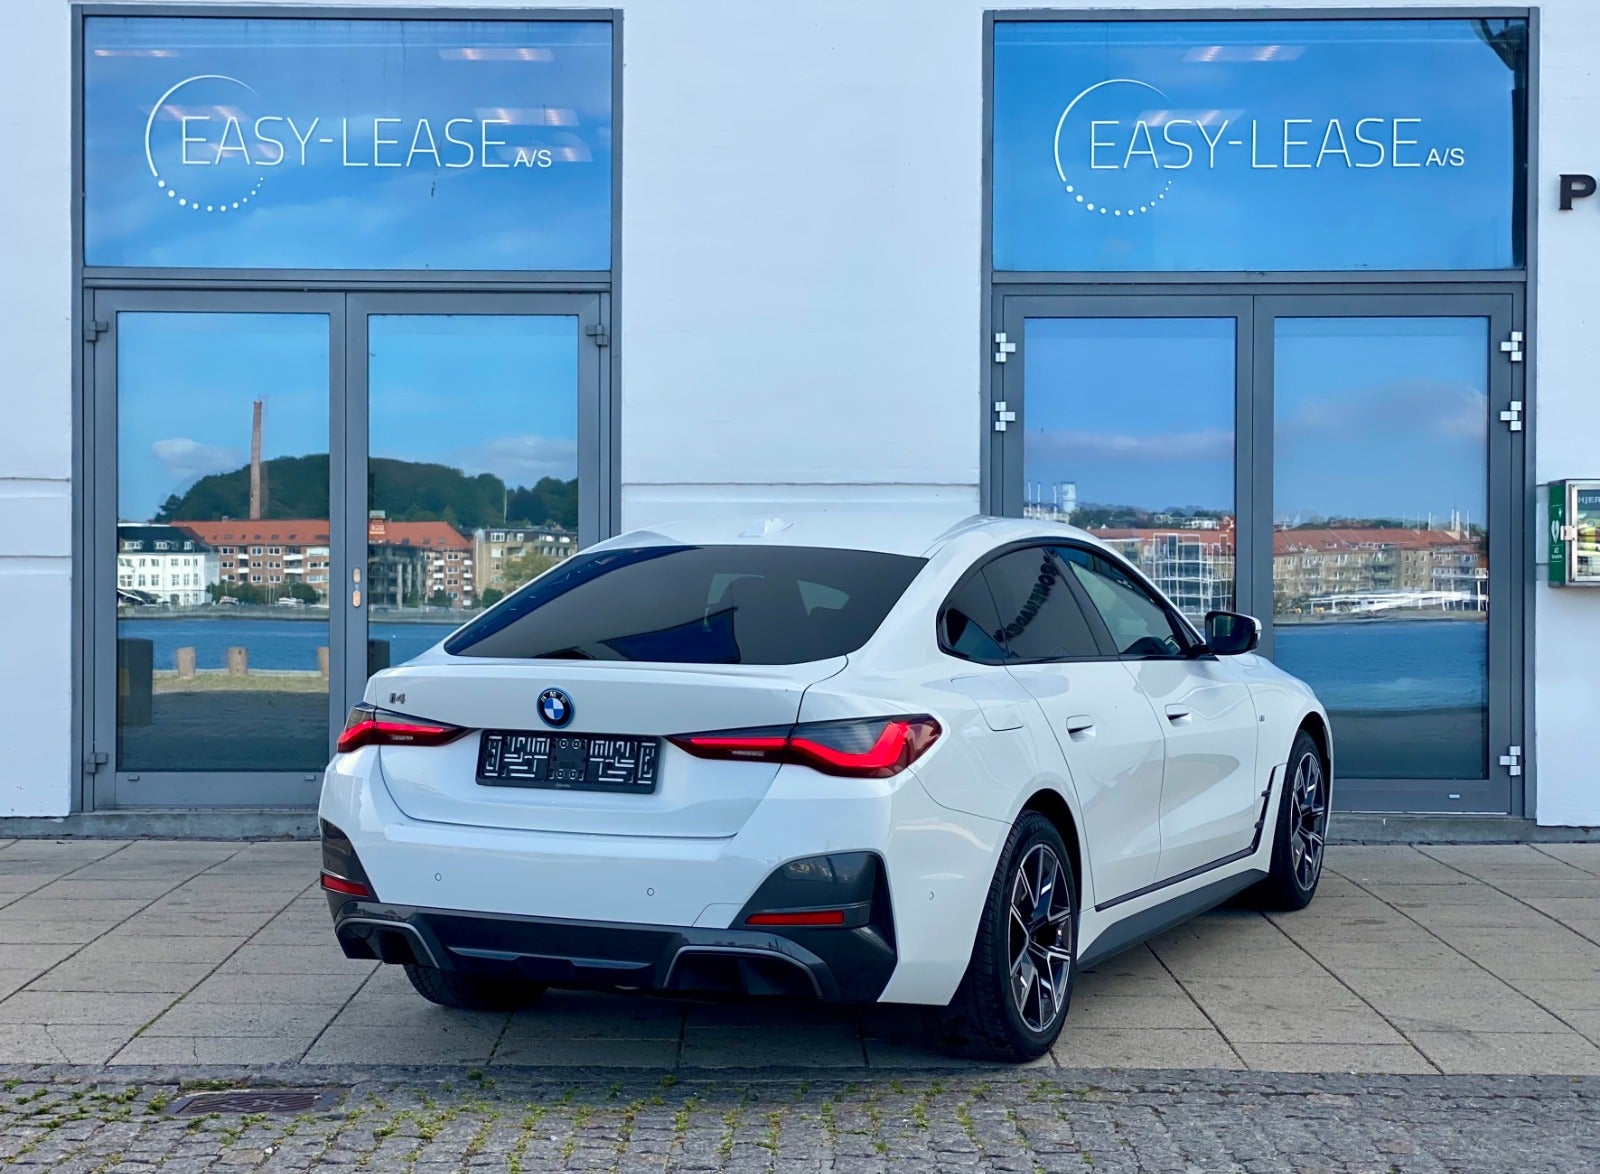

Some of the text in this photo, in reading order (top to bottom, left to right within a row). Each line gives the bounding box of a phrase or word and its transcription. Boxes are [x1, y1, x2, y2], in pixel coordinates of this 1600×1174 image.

[181, 115, 553, 169] EASY-LEASE A/S
[1090, 117, 1466, 169] EASY-LEASE A/S
